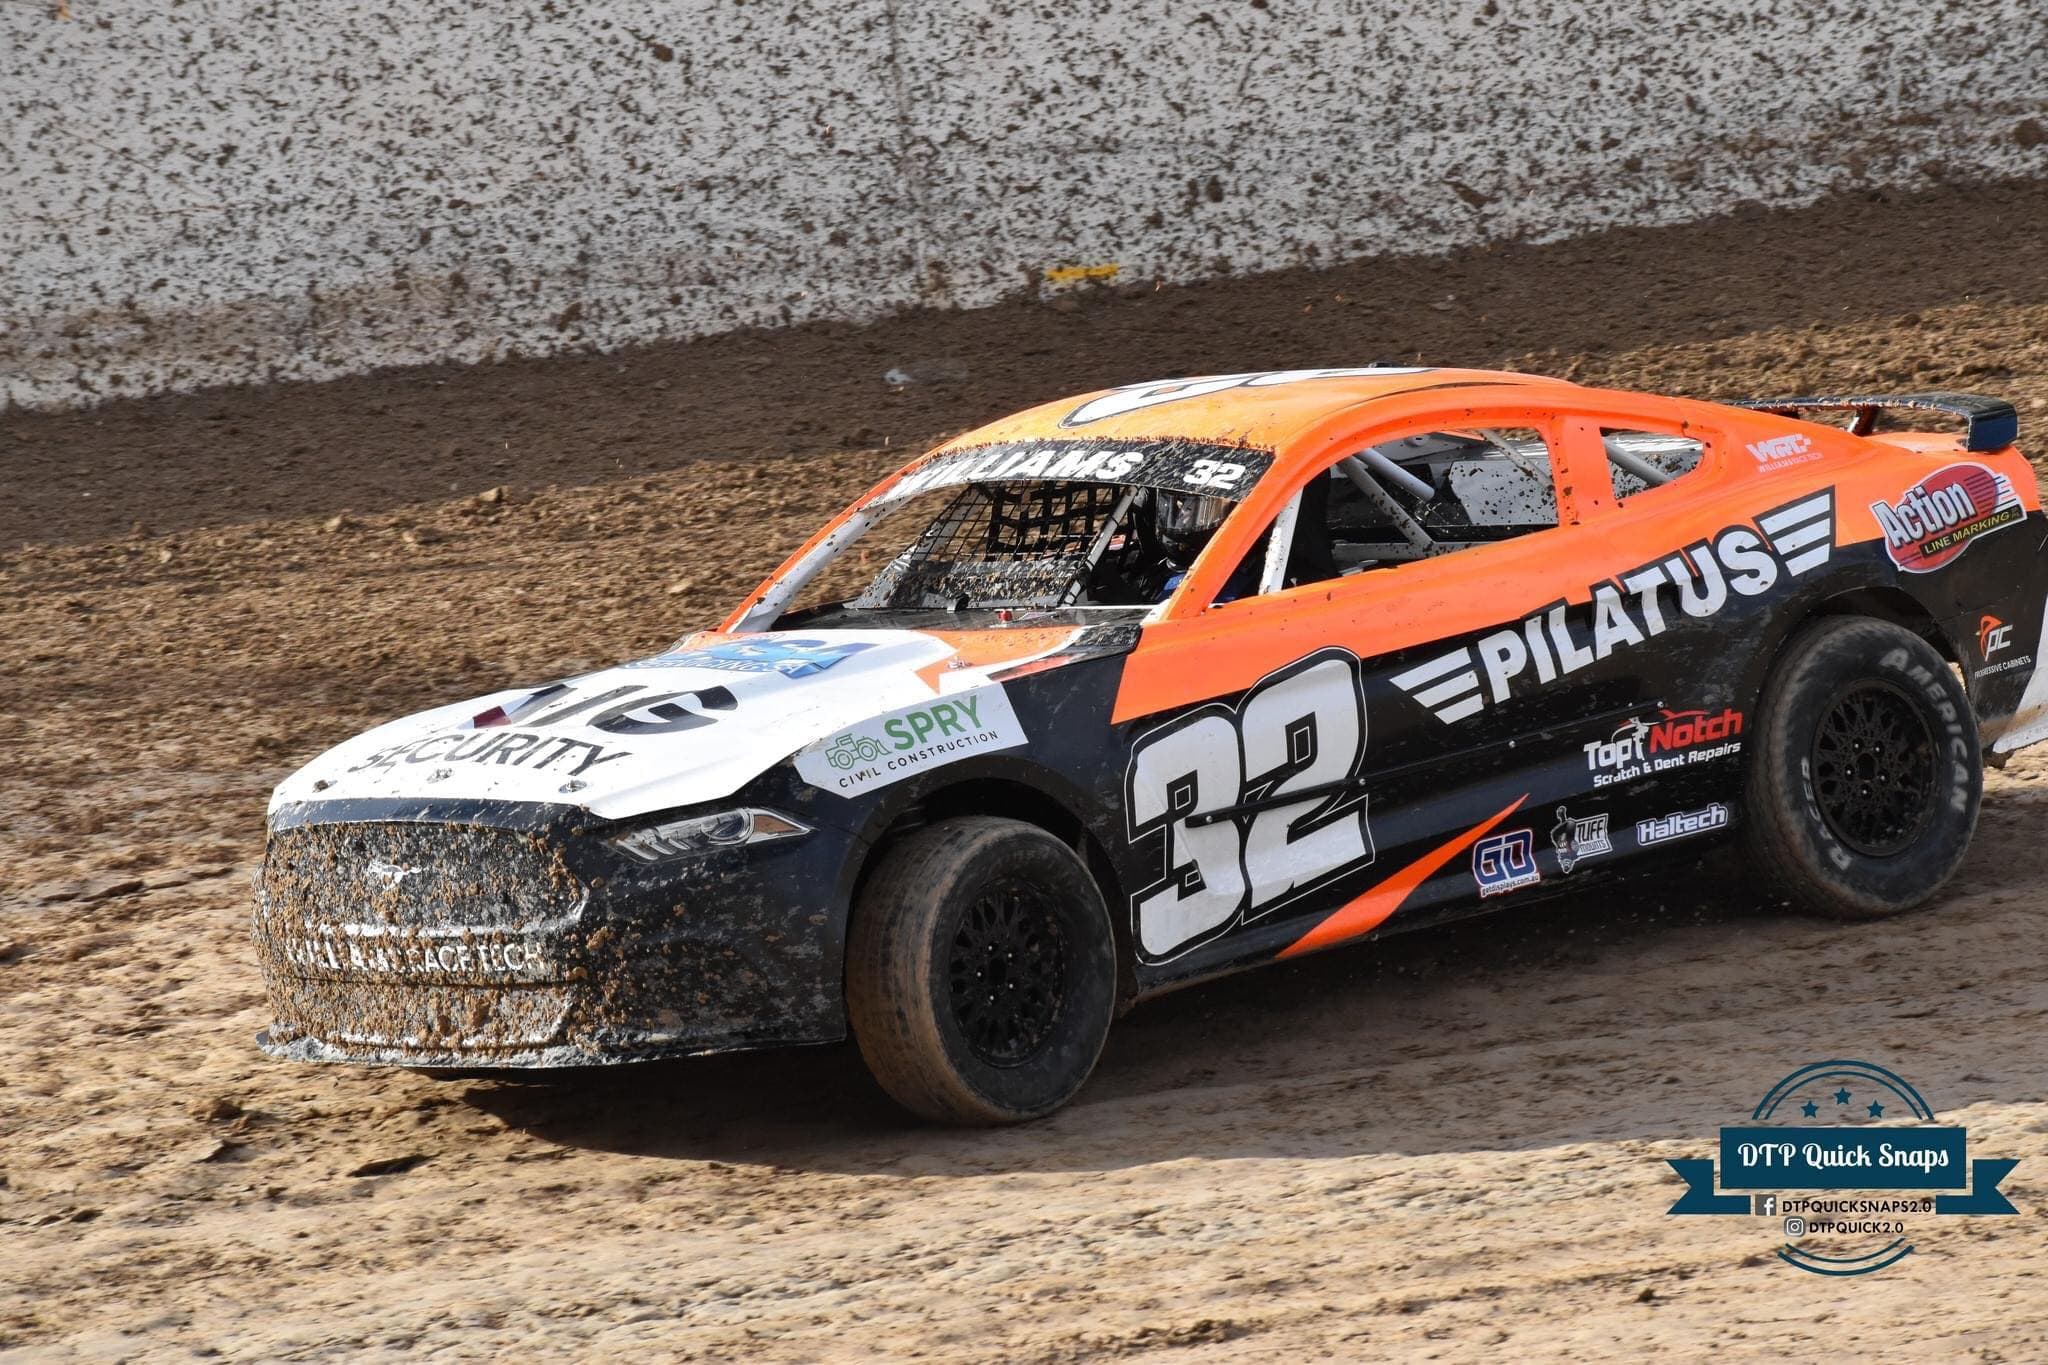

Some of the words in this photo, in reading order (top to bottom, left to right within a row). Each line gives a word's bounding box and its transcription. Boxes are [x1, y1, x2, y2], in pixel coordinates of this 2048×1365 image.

[1182, 459, 1246, 489] 32
[1872, 482, 1977, 548] Action
[1924, 537, 1950, 554] LINE
[1953, 511, 2010, 542] MARKING
[1477, 530, 1778, 704] PILATUS
[2002, 655, 2032, 671] CABINETS
[884, 694, 984, 751] SPRY
[1583, 737, 1633, 770] Top
[1648, 708, 1744, 754] Notch
[347, 732, 634, 777] SECURITY
[839, 766, 882, 788] CIVIL
[887, 730, 999, 770] CONSTRUCTION
[1593, 765, 1640, 788] Scratch
[1643, 762, 1652, 774] &
[1654, 753, 1686, 771] Dent
[1688, 742, 1742, 764] Repairs
[1130, 653, 1371, 960] 32
[1638, 804, 1727, 843] Haltech
[1576, 819, 1605, 844] TUFF
[477, 942, 546, 972] TECH
